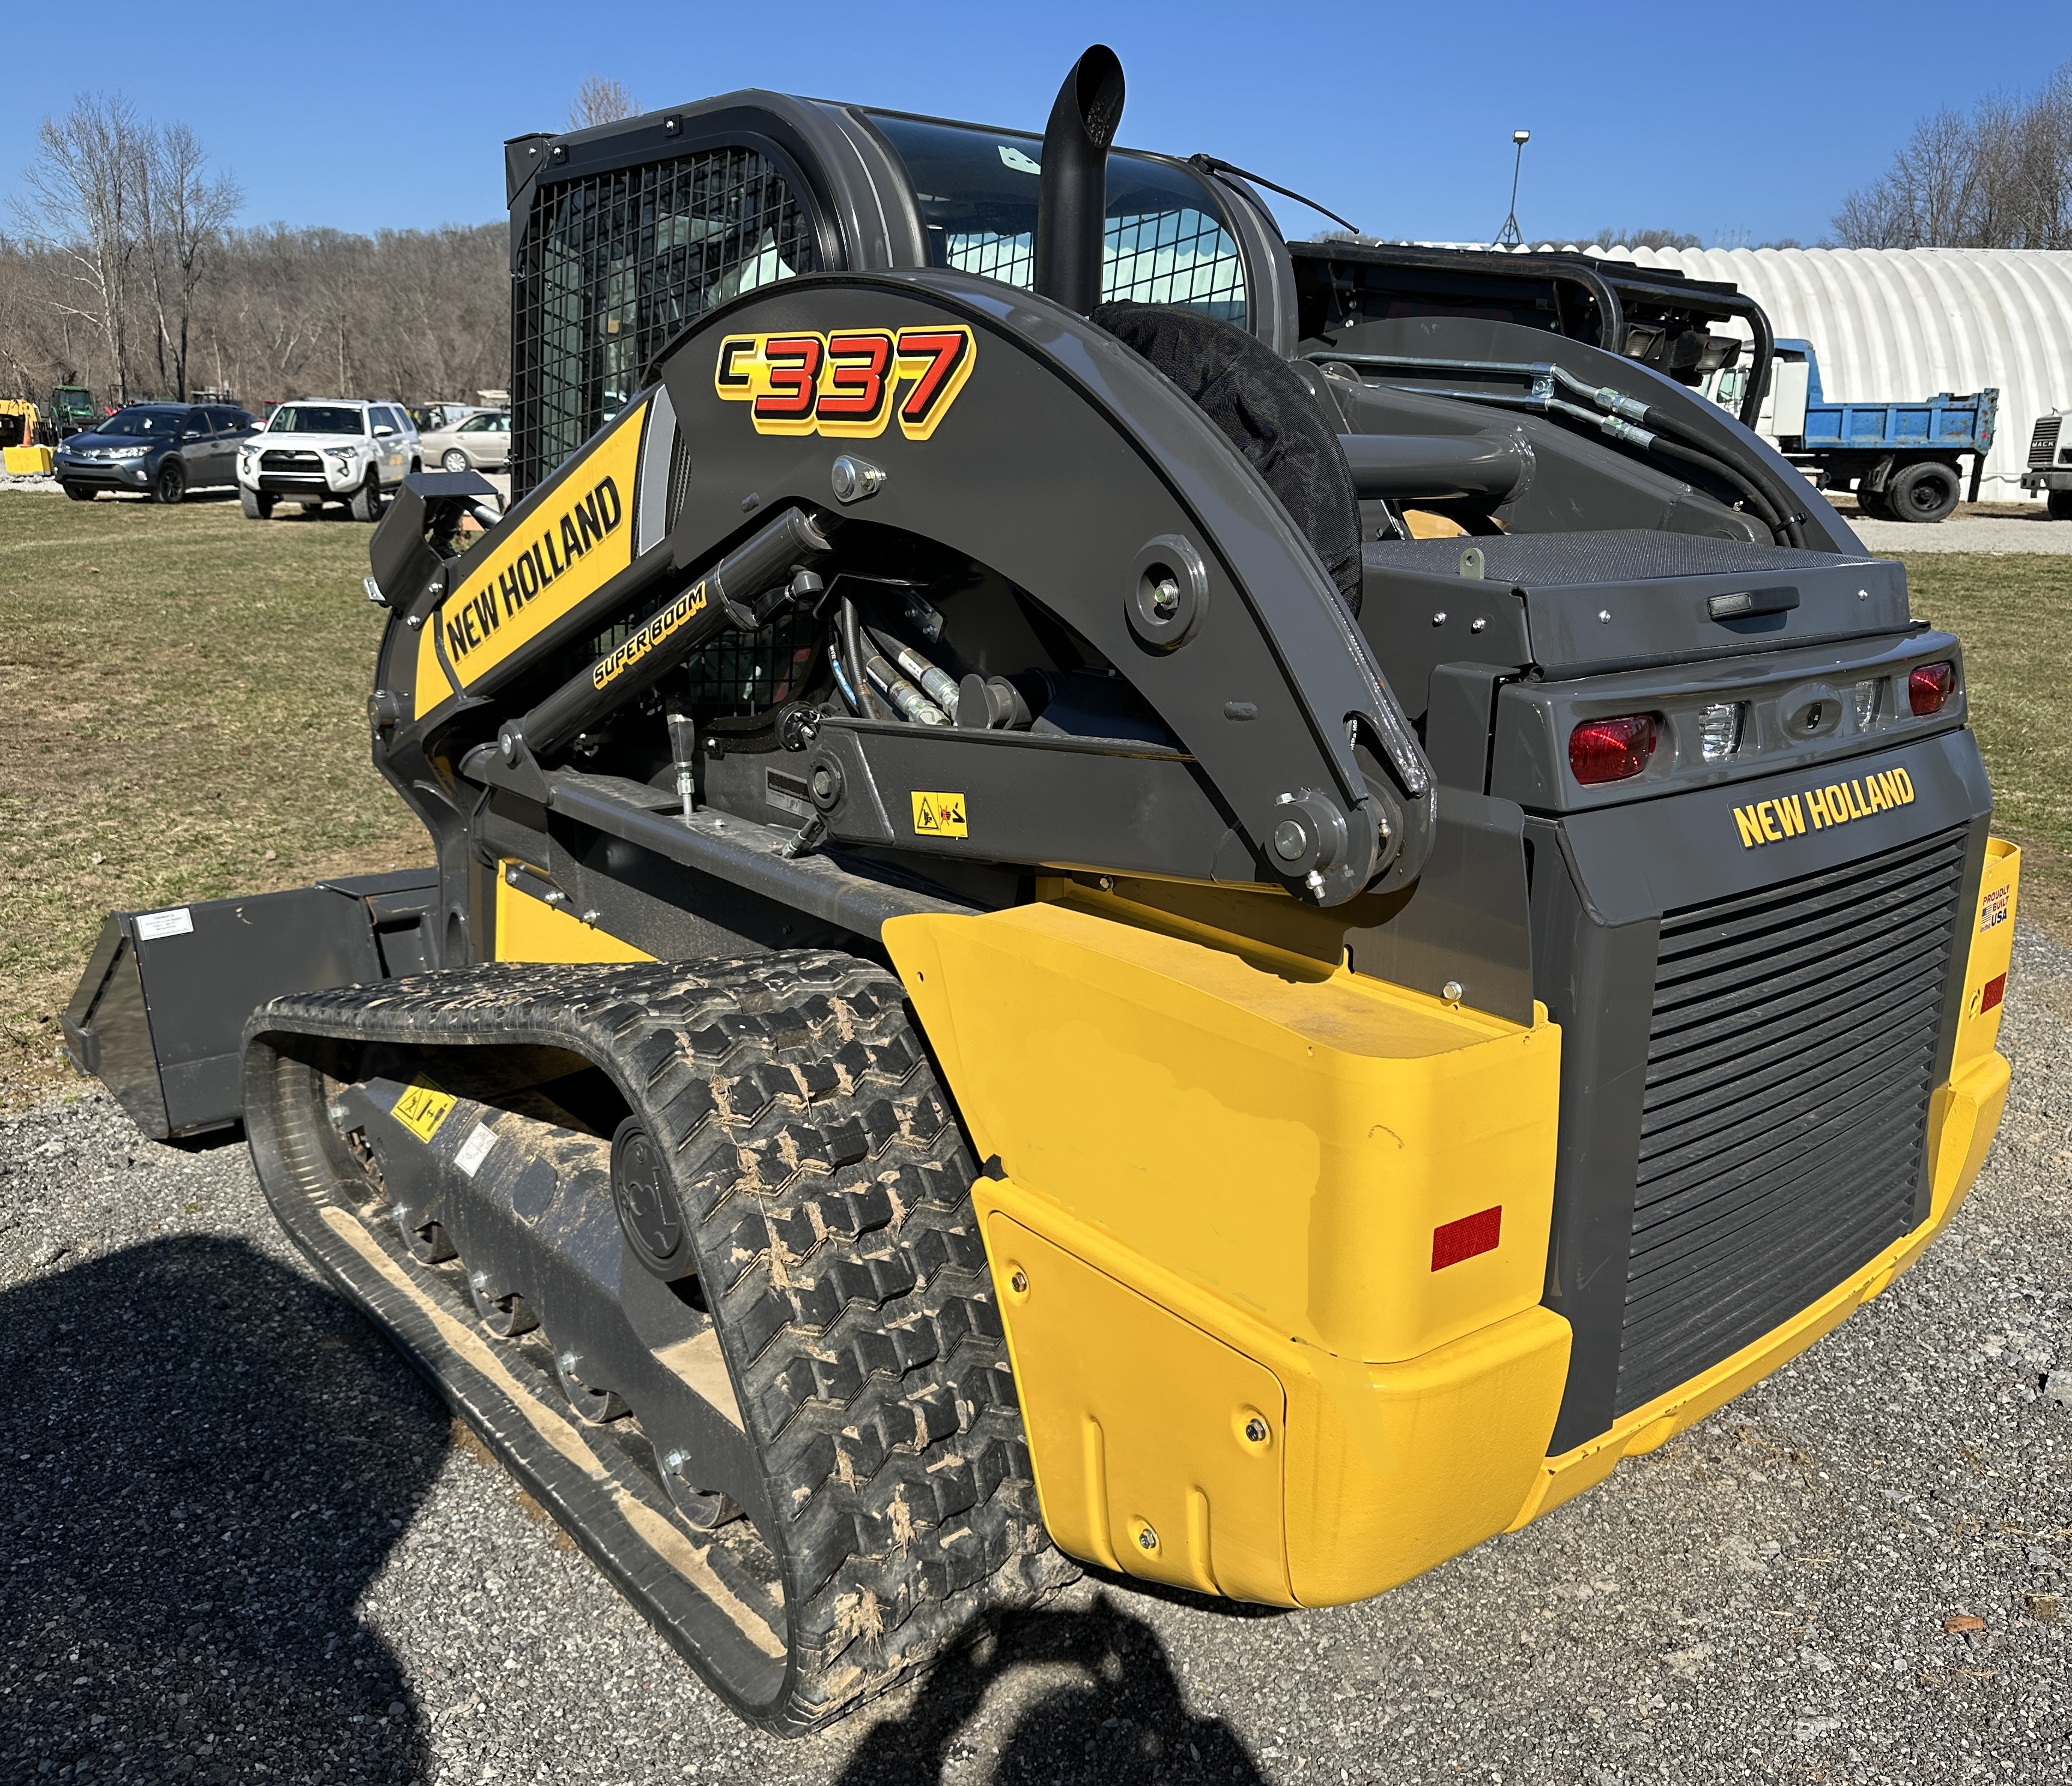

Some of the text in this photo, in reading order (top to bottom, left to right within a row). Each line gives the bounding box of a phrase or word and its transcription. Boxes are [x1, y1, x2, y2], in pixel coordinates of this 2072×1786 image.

[446, 475, 622, 664] NEW HOLLAND
[594, 580, 707, 688] SUPER BOOM
[1733, 767, 1915, 848] NEW HOLLAND
[1982, 883, 2010, 906] PROUDLY
[1991, 907, 2007, 927] USA
[1992, 895, 2010, 912] BUILT
